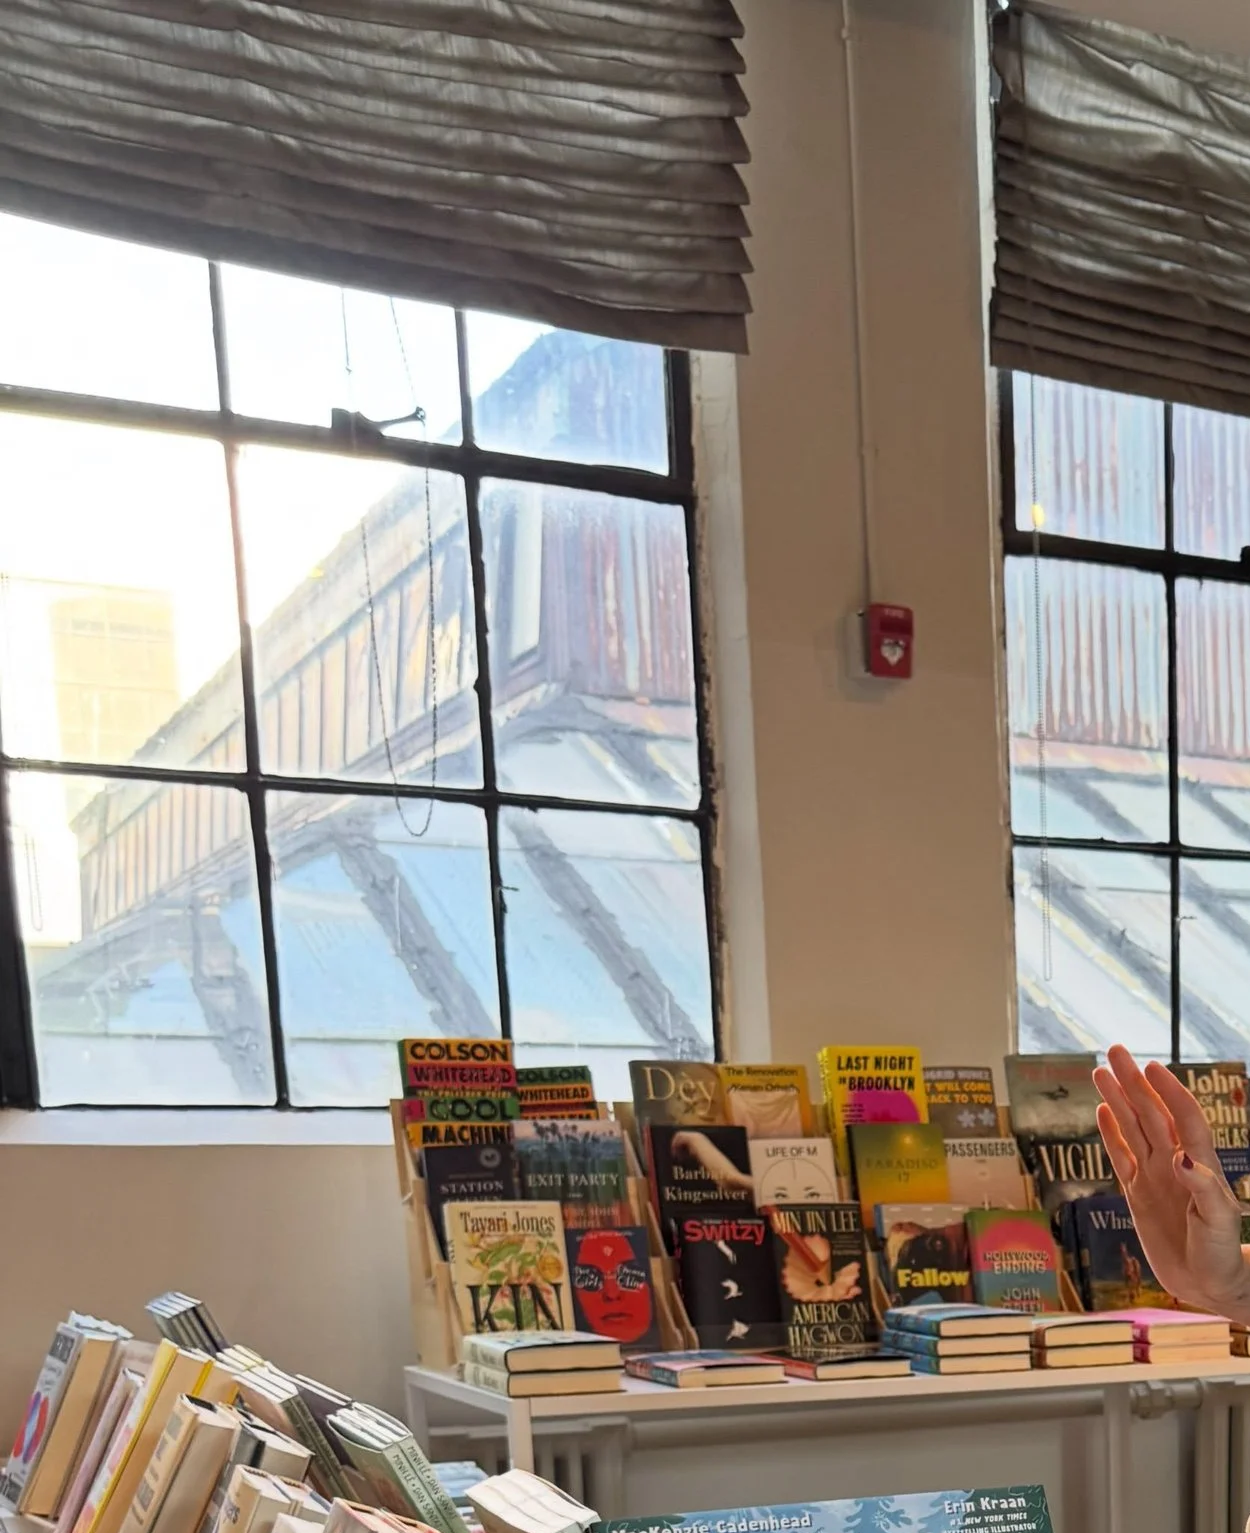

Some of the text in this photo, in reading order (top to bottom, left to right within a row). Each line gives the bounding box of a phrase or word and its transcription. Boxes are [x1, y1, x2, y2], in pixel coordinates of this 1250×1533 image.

[410, 1042, 509, 1063] COLSON
[725, 1067, 798, 1077] The Renovation
[837, 1056, 915, 1071] LAST NIGHT
[412, 1066, 513, 1084] WHITEHEAD
[517, 1069, 586, 1084] COLSON
[848, 1076, 915, 1091] BROOKLYN
[1187, 1069, 1244, 1096] John
[518, 1087, 589, 1101] WHITEHEAD
[935, 1082, 962, 1092] WILL
[964, 1082, 992, 1093] COME
[930, 1094, 993, 1104] ACK TO YOU
[430, 1099, 513, 1120] COOL
[1204, 1100, 1247, 1125] ohn
[766, 1147, 787, 1157] LIFE
[790, 1146, 805, 1156] OF
[946, 1141, 1016, 1158] PASSENGERS
[1039, 1143, 1113, 1182] VIGIL
[439, 1180, 504, 1194] STATION
[527, 1172, 619, 1187] EXIT PARTY
[664, 1186, 749, 1204] Kingsolver
[460, 1211, 508, 1234] Tayari
[512, 1211, 556, 1233] Jones
[773, 1210, 800, 1233] MIN
[831, 1211, 860, 1232] LEE
[683, 1219, 766, 1245] Switzy
[985, 1250, 1049, 1262] HOLLYWOOD
[994, 1260, 1047, 1274] ENDING
[897, 1268, 970, 1288] Fallow
[1003, 1287, 1041, 1300] JOHN
[466, 1283, 562, 1333] KIN
[793, 1303, 871, 1325] AMERICAN
[787, 1326, 866, 1347] HAGWON
[944, 1497, 1026, 1514] Erin Kraan
[964, 1516, 982, 1526] NEW
[984, 1513, 1004, 1523] YORK
[1006, 1512, 1028, 1521] TIMES
[990, 1523, 1037, 1533] ILLUSTRATOR
